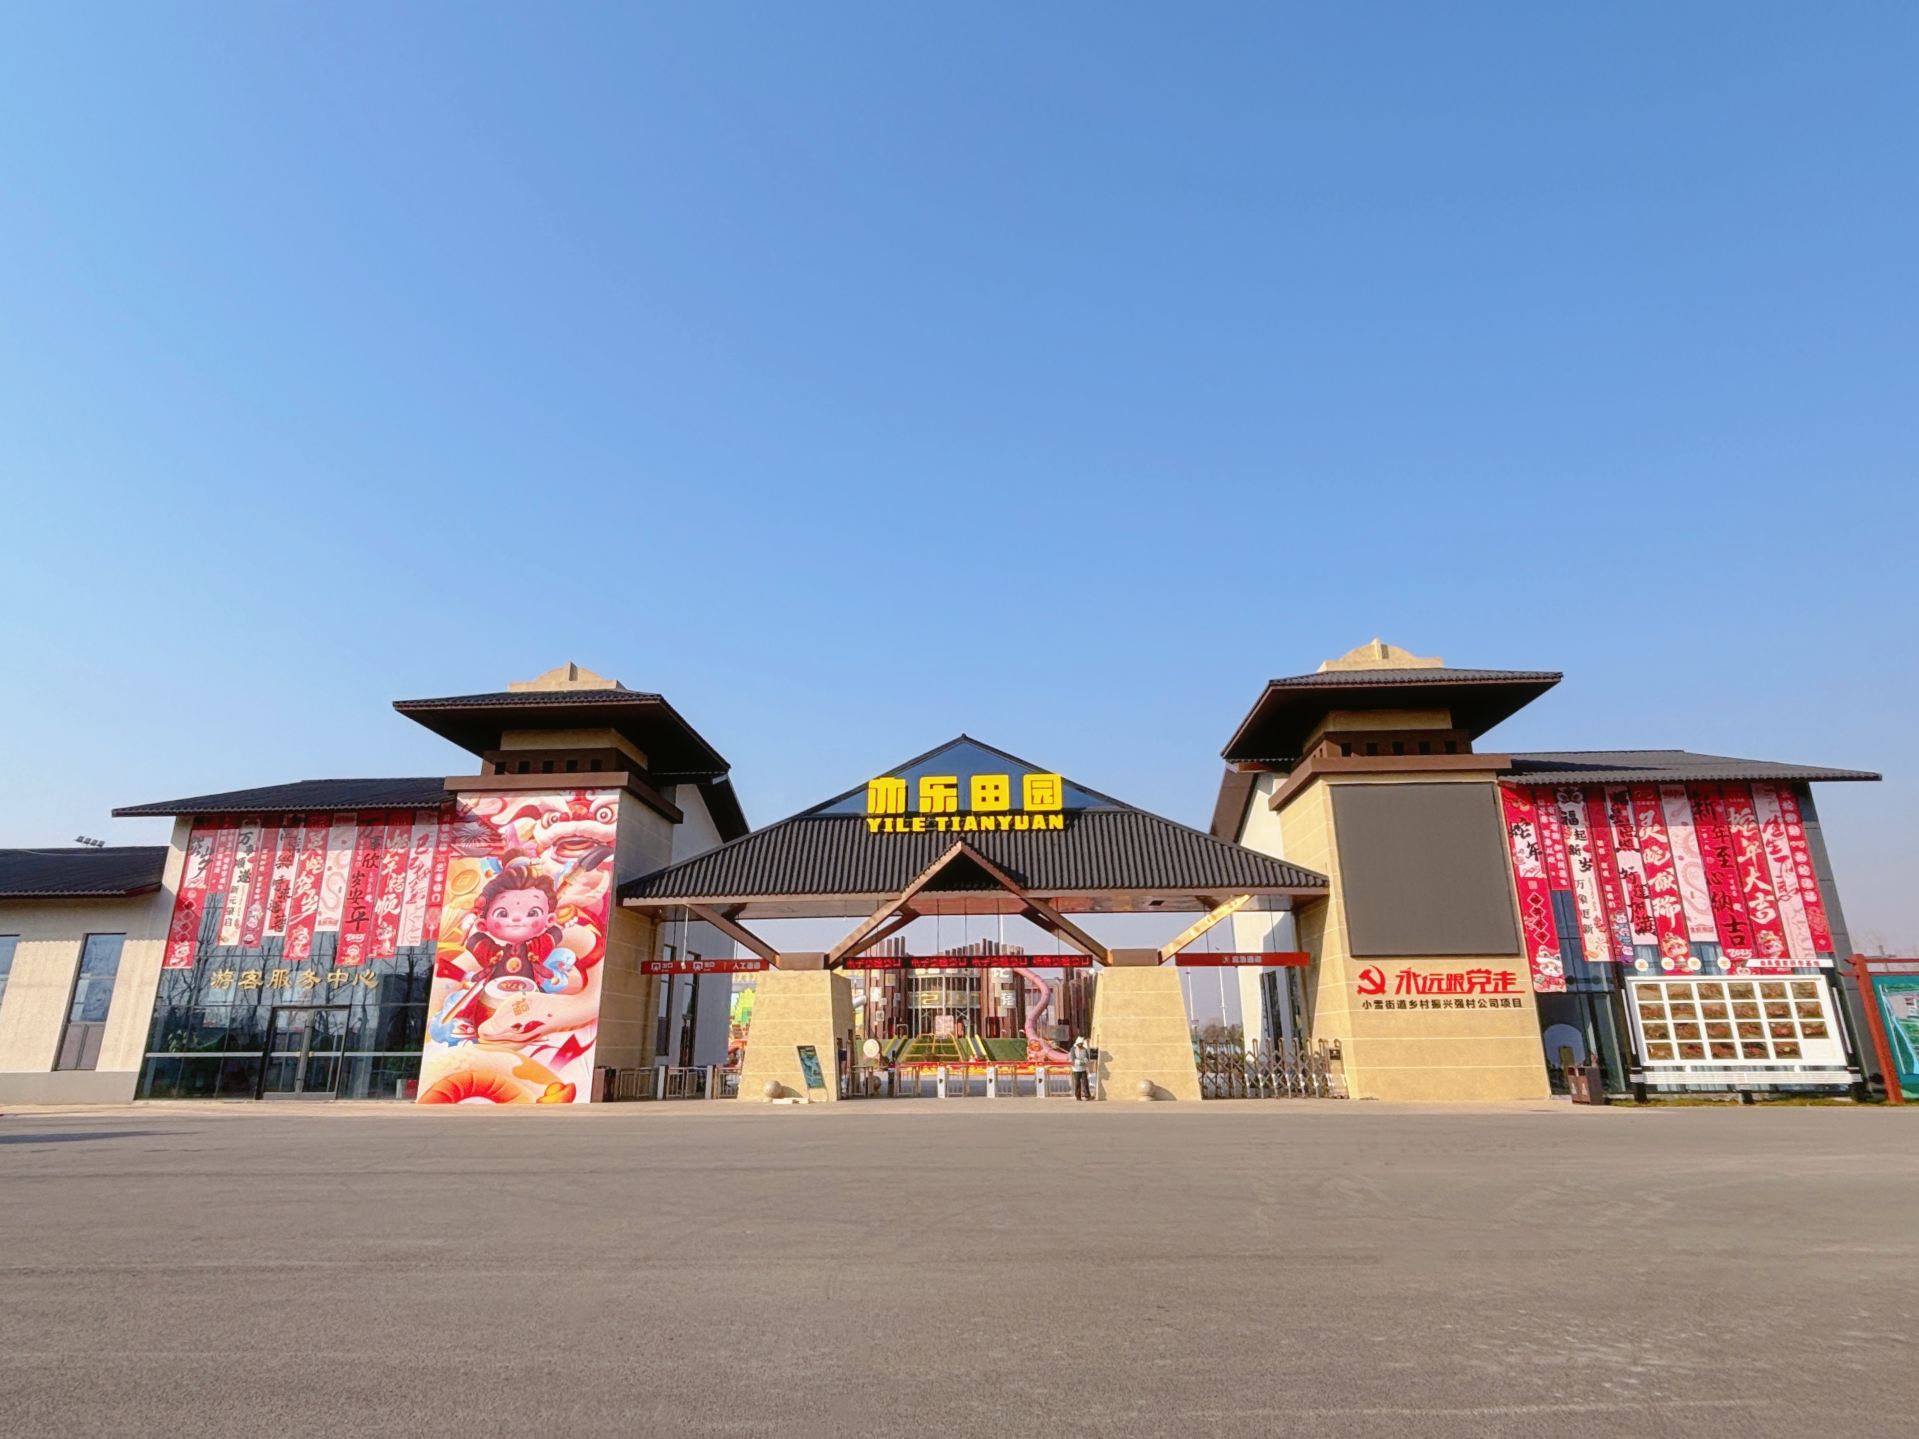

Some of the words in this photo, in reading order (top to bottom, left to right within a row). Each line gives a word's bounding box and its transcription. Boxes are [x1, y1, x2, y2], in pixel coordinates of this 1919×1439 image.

[867, 817, 926, 833] YILE
[935, 814, 1065, 832] TIANYUAN
[1727, 806, 1776, 925] 蛇年大吉
[732, 961, 761, 971] 人工
[210, 968, 380, 991] 游客服务中心
[1395, 967, 1526, 995] 永远跟党走
